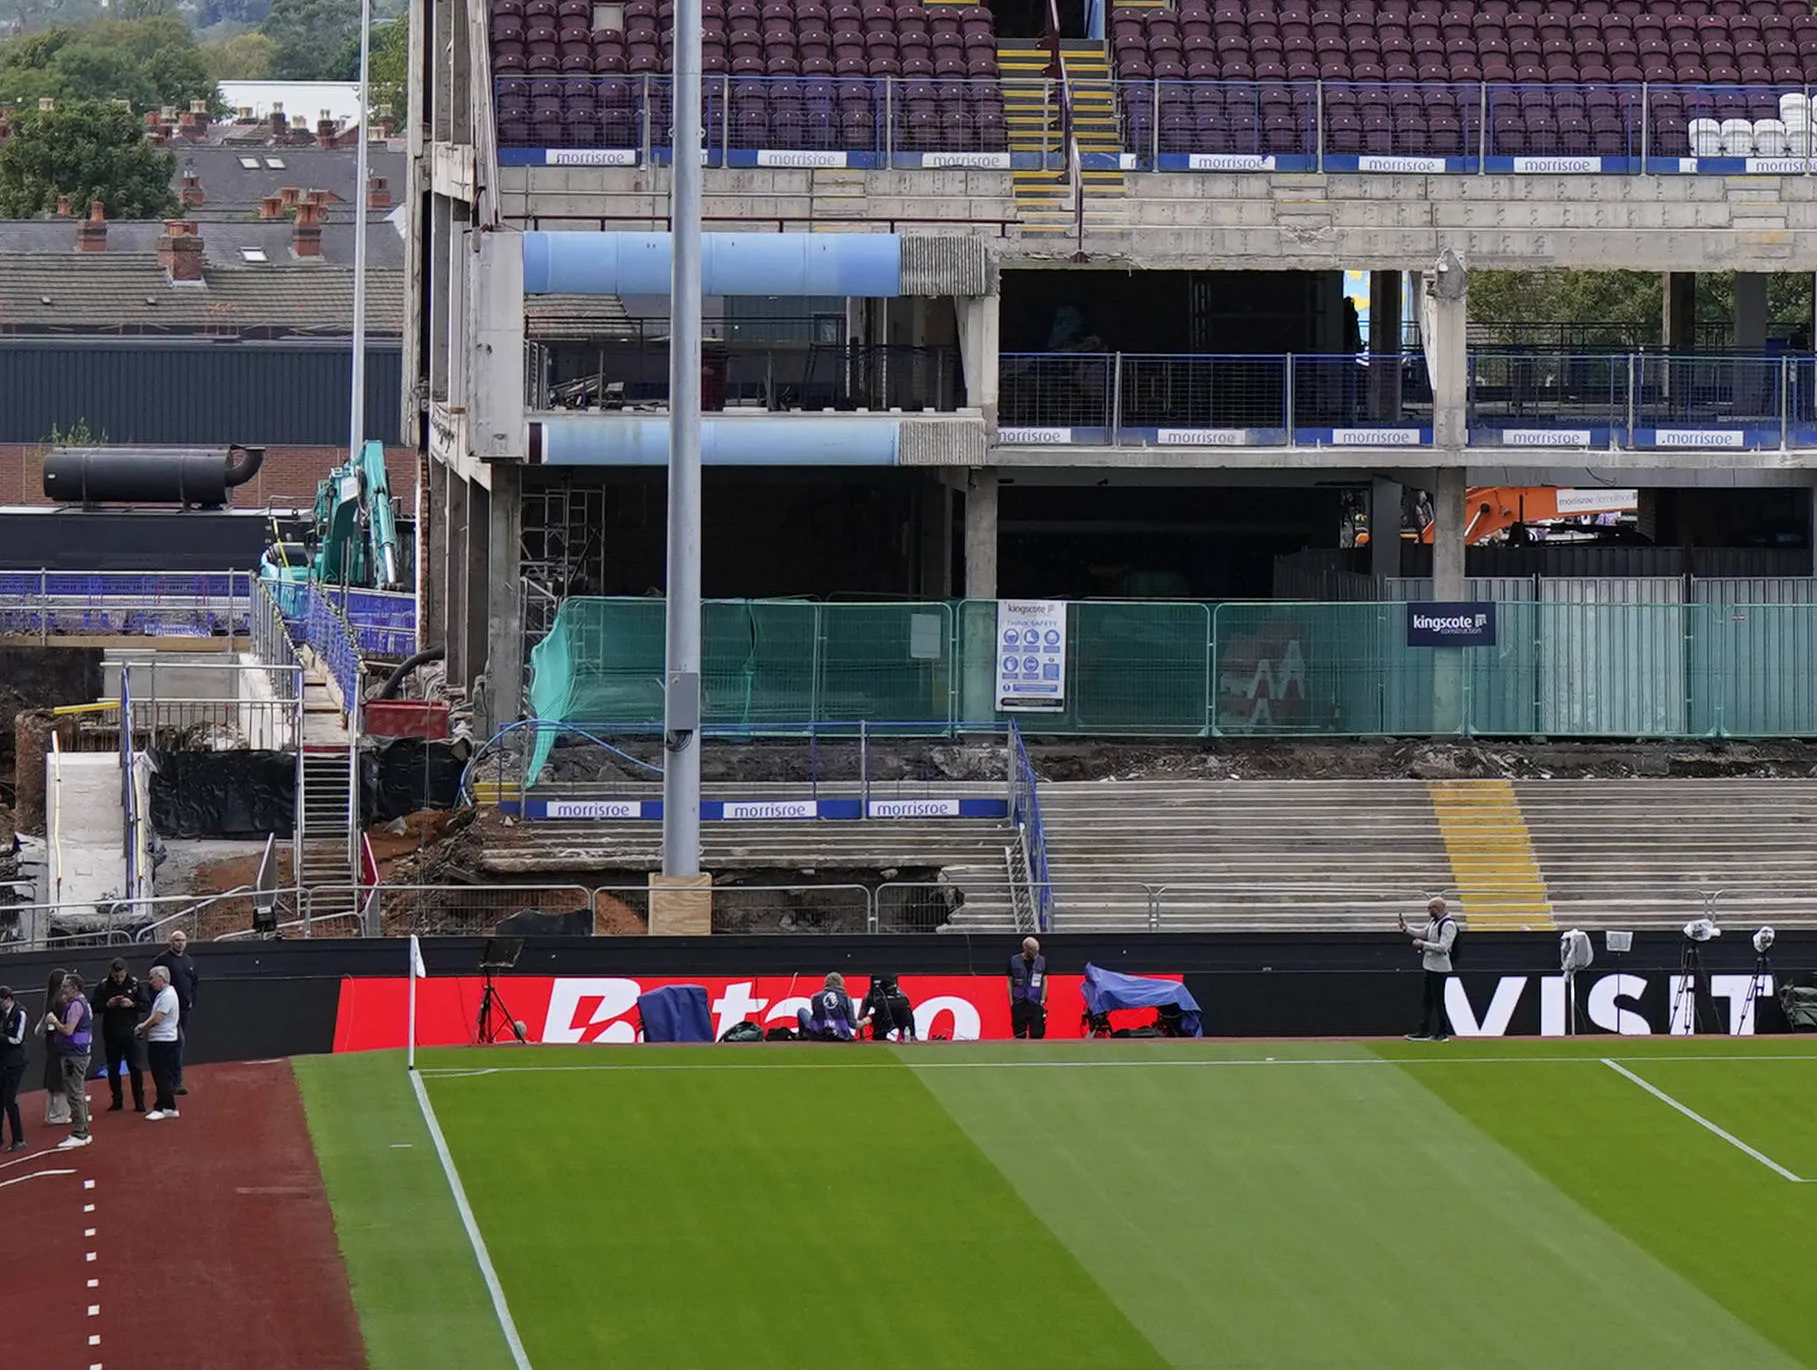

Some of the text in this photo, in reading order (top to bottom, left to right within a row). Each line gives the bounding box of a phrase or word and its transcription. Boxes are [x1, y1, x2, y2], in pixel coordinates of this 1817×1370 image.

[556, 151, 625, 164] morrisroe
[768, 152, 836, 166] morrisroe
[932, 153, 1000, 167] morrisroe
[1198, 155, 1267, 169] morrisroe
[1368, 157, 1435, 171] morrisroe
[1524, 158, 1591, 172] morrisroe
[1168, 430, 1236, 444] morrisroe
[1343, 430, 1409, 444] morrisroe
[1513, 431, 1581, 445] morrisroe
[1666, 431, 1732, 445] morrisroe
[1413, 614, 1473, 632] kingscote
[558, 803, 630, 817] morrisroe
[734, 803, 806, 818] morrisroe
[877, 800, 948, 816] morrisroe
[1443, 973, 1774, 1036] VISIT
